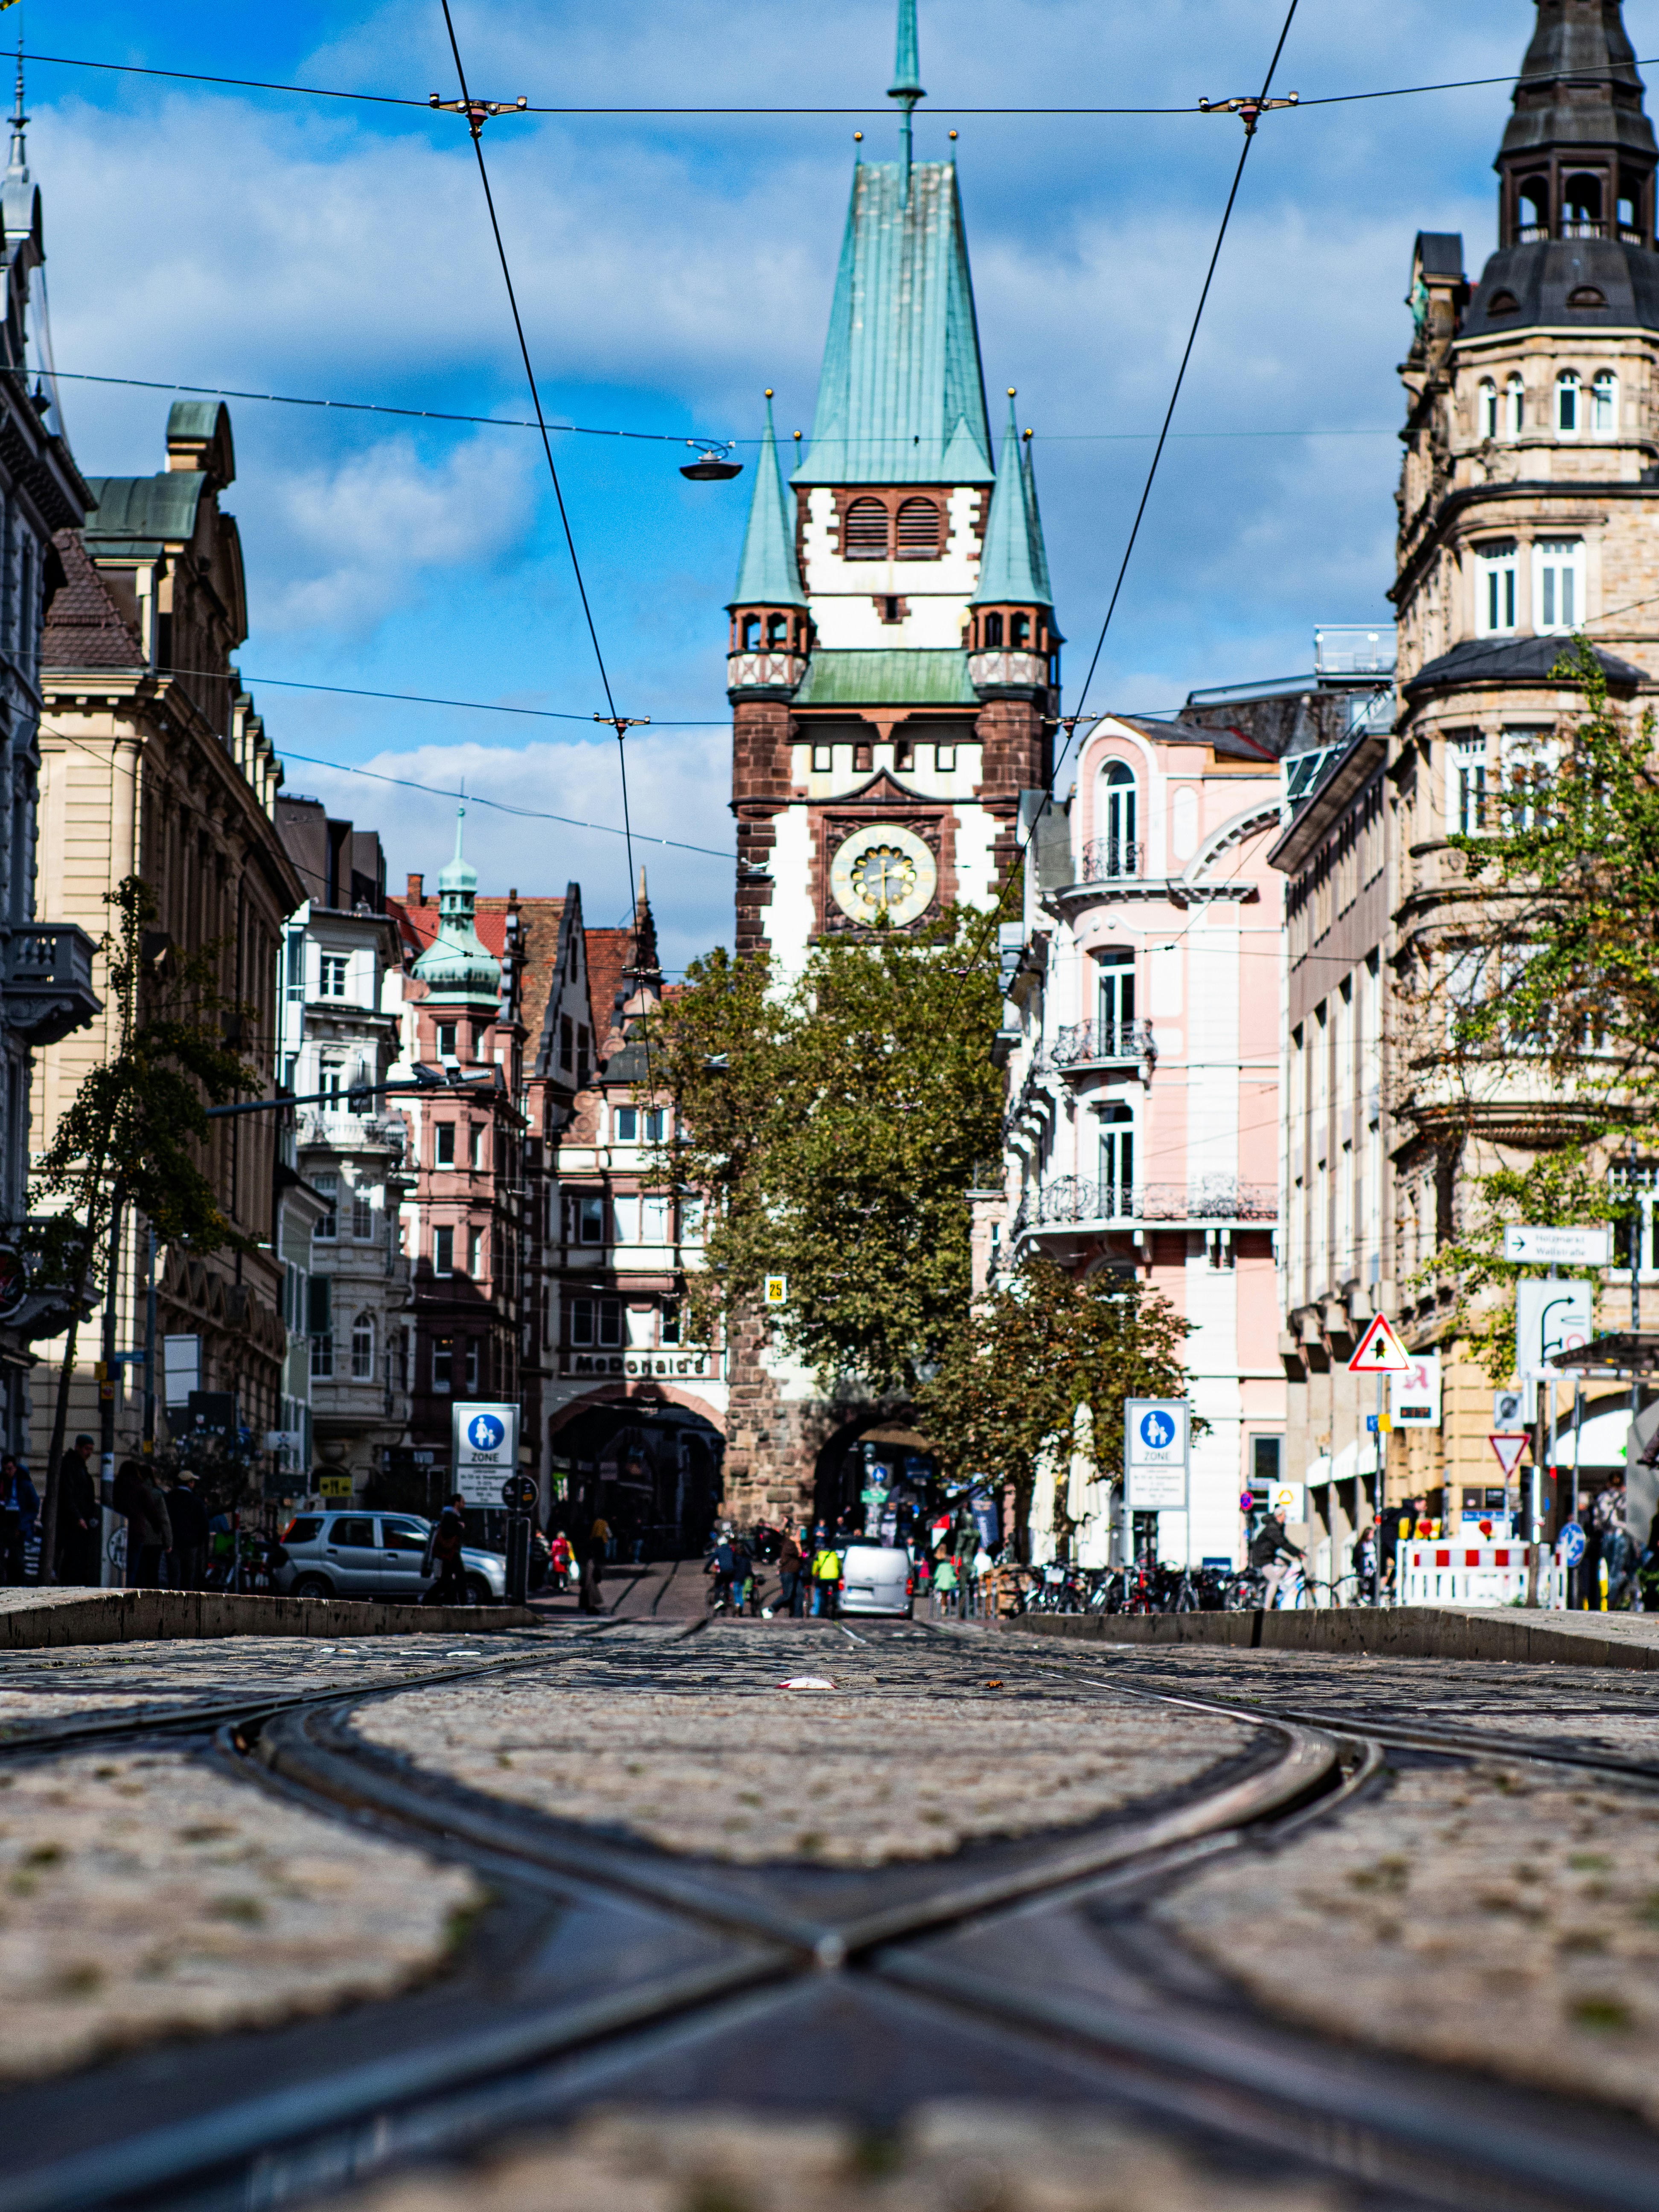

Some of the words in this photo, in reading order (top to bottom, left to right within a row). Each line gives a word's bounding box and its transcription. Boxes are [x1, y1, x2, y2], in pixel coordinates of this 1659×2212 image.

[770, 1284, 782, 1296] 25
[472, 1452, 498, 1462] ZONE
[1144, 1451, 1170, 1461] ZONE
